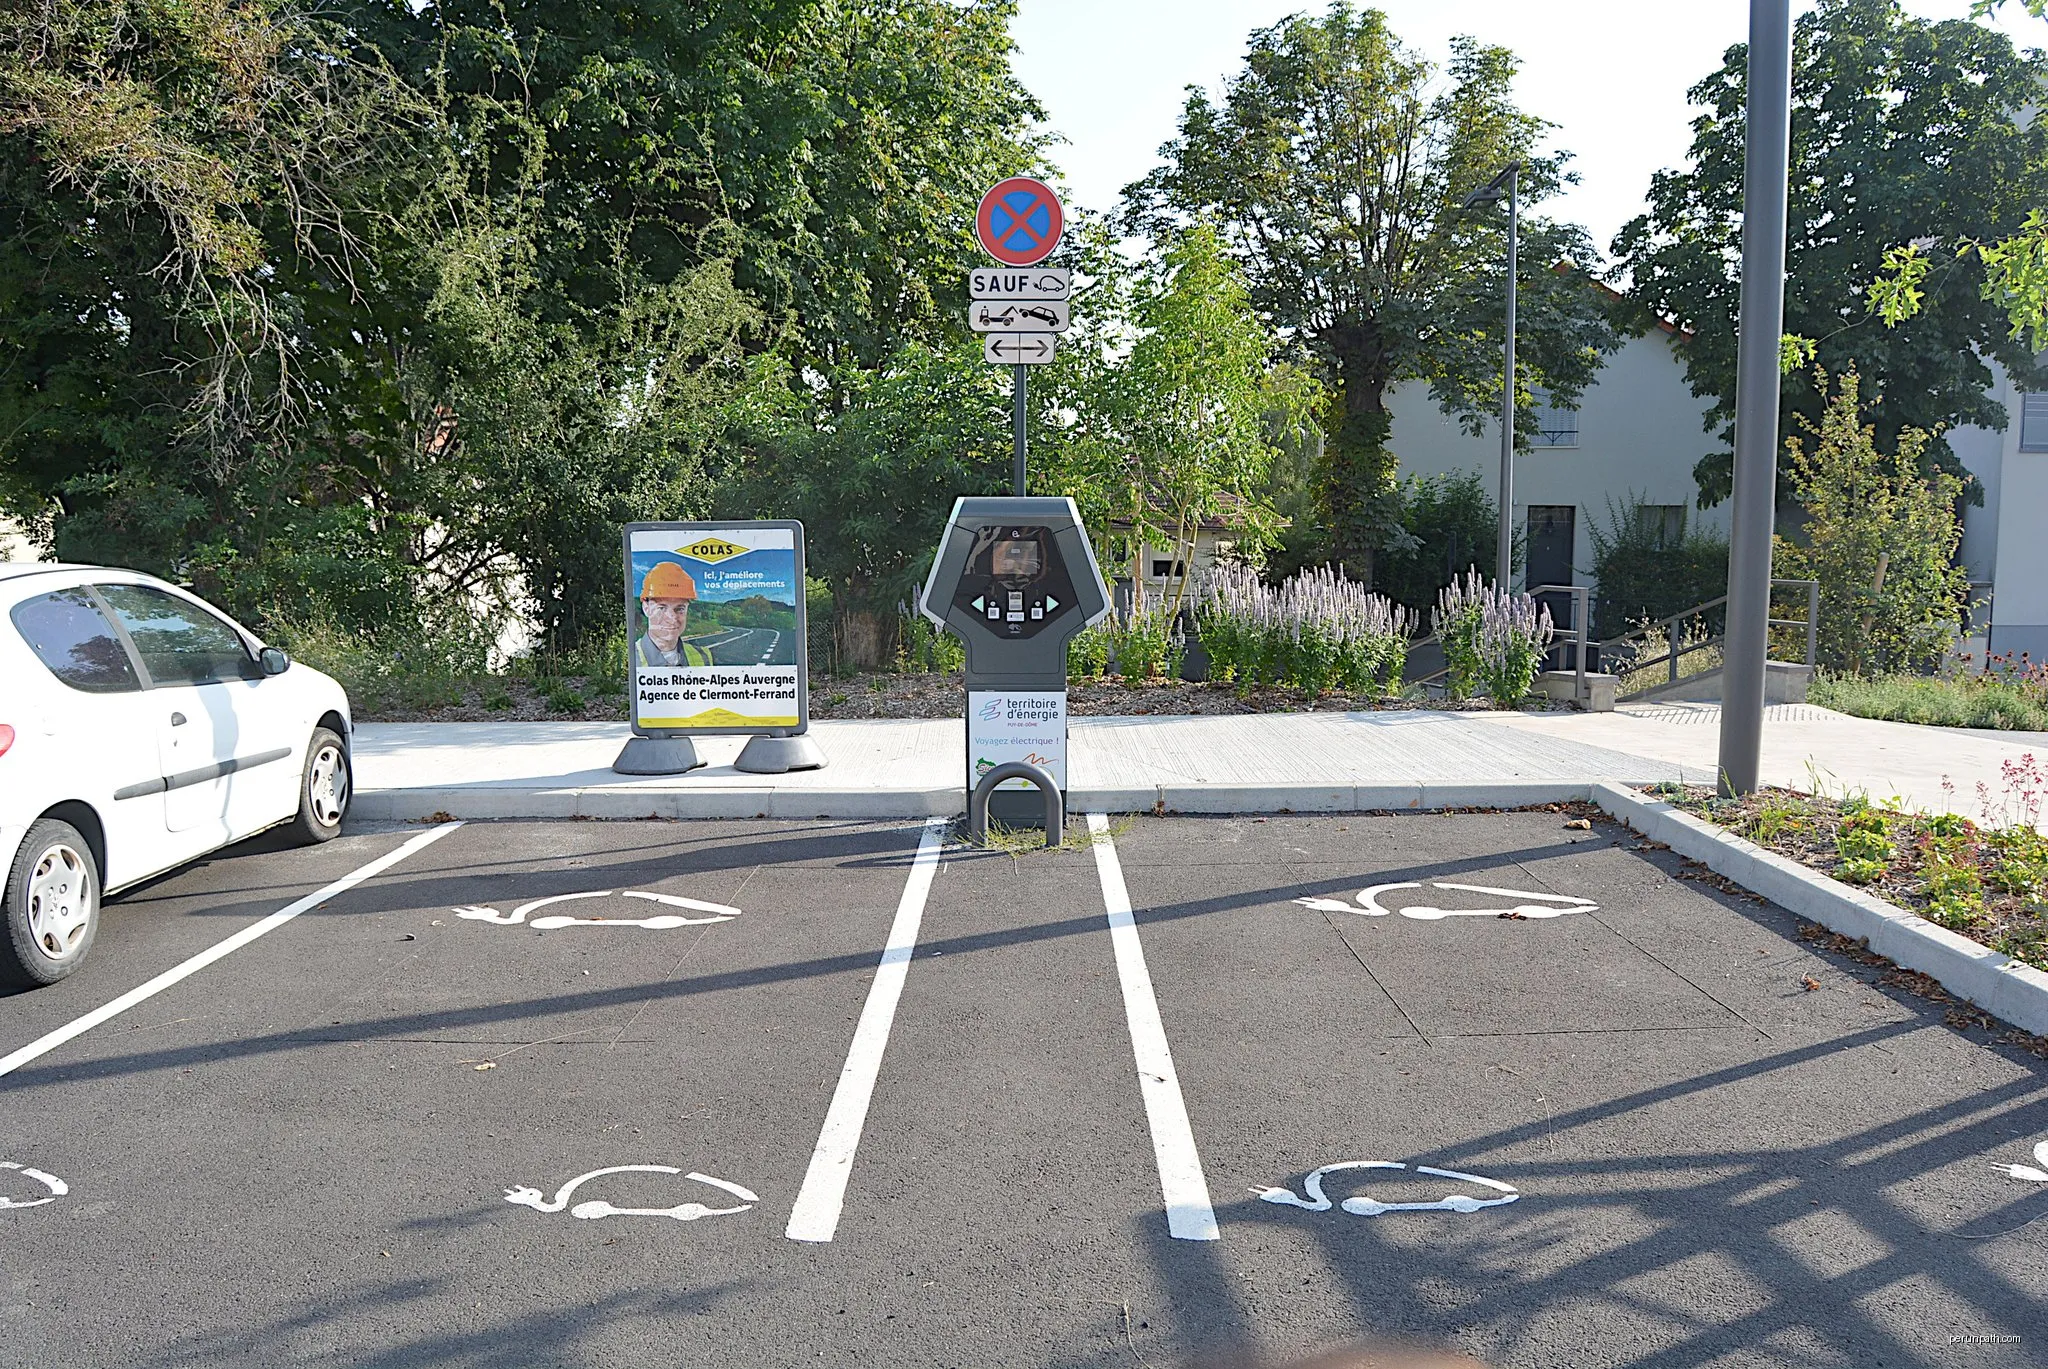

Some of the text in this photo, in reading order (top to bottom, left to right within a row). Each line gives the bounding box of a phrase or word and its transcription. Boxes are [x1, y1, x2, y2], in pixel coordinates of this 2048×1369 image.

[973, 275, 1029, 292] SAUF
[691, 544, 733, 556] COLAS
[704, 570, 764, 580] Ici, j'améliore
[722, 580, 785, 590] déplacements
[638, 674, 795, 687] Colas Rhône-Alpes Auvergne
[639, 688, 795, 703] Agence de Clermont-Ferrand
[1007, 698, 1057, 709] territoire
[1007, 709, 1059, 721] d'énergie
[975, 737, 1008, 746] Voyagez
[1011, 736, 1053, 745] électrique
